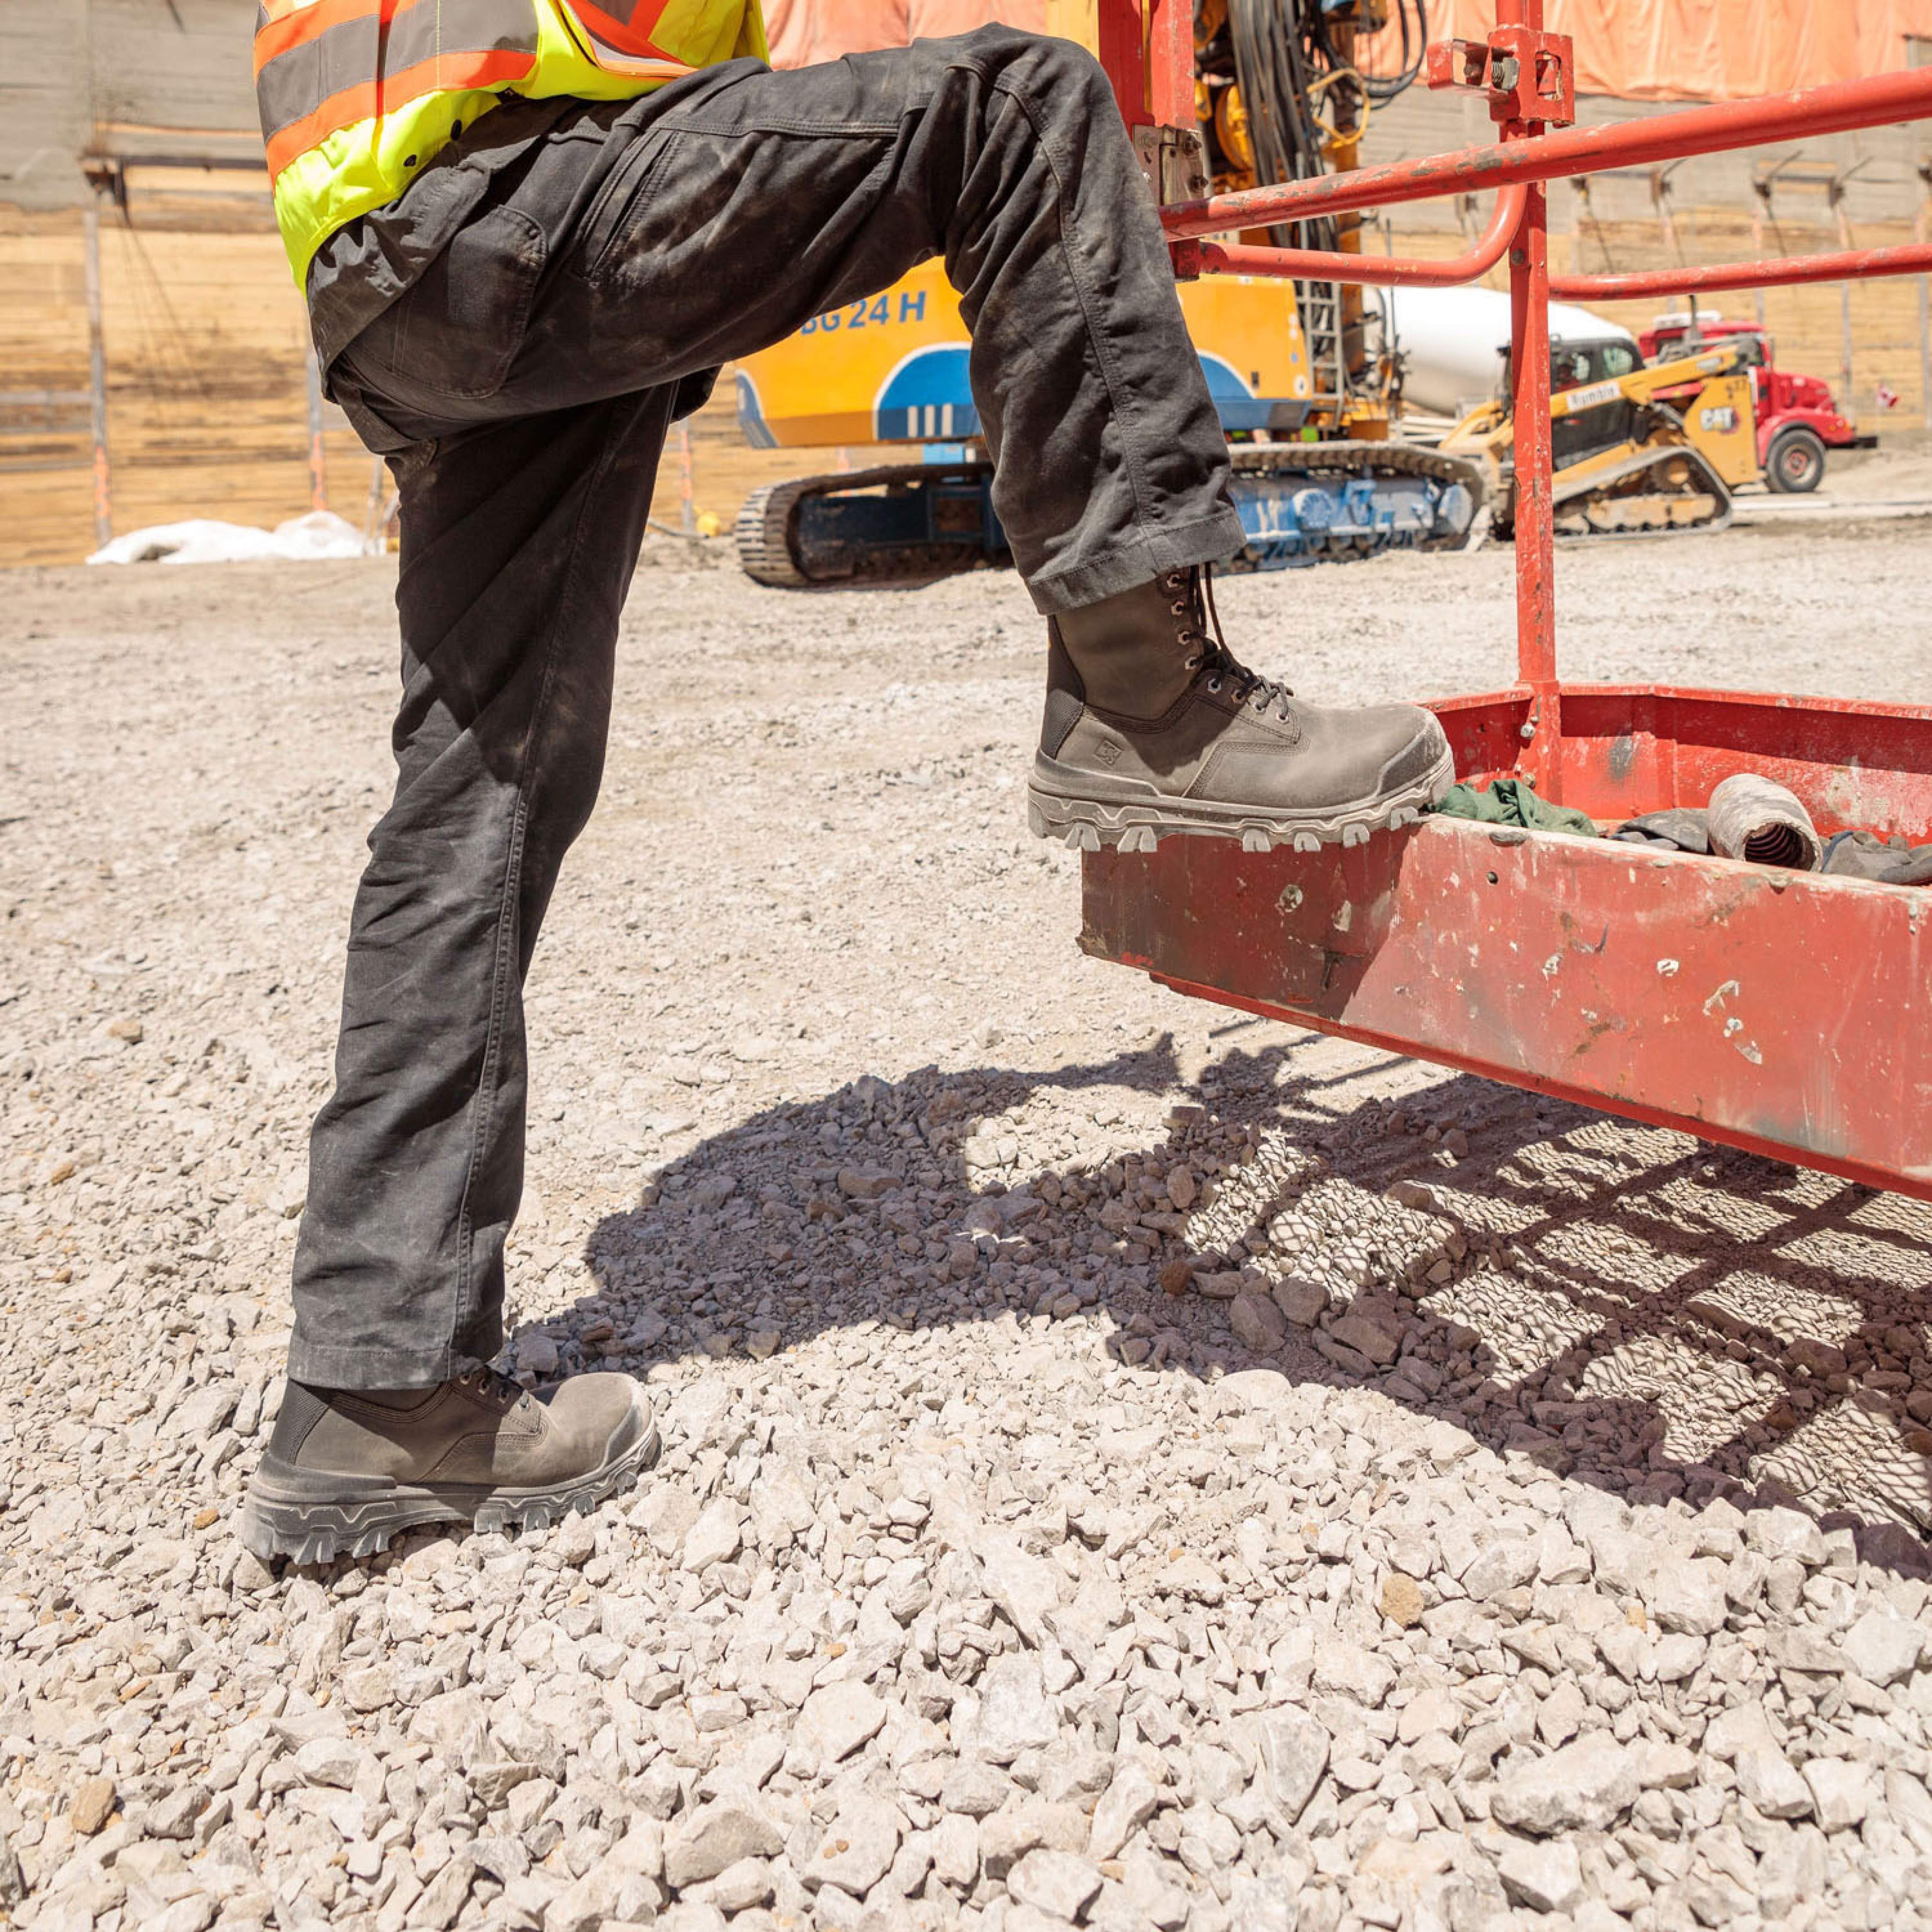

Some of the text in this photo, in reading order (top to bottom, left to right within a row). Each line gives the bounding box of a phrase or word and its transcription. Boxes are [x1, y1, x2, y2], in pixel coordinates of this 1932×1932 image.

[848, 295, 889, 328] 24
[899, 291, 926, 323] H
[1700, 407, 1733, 431] CAT
